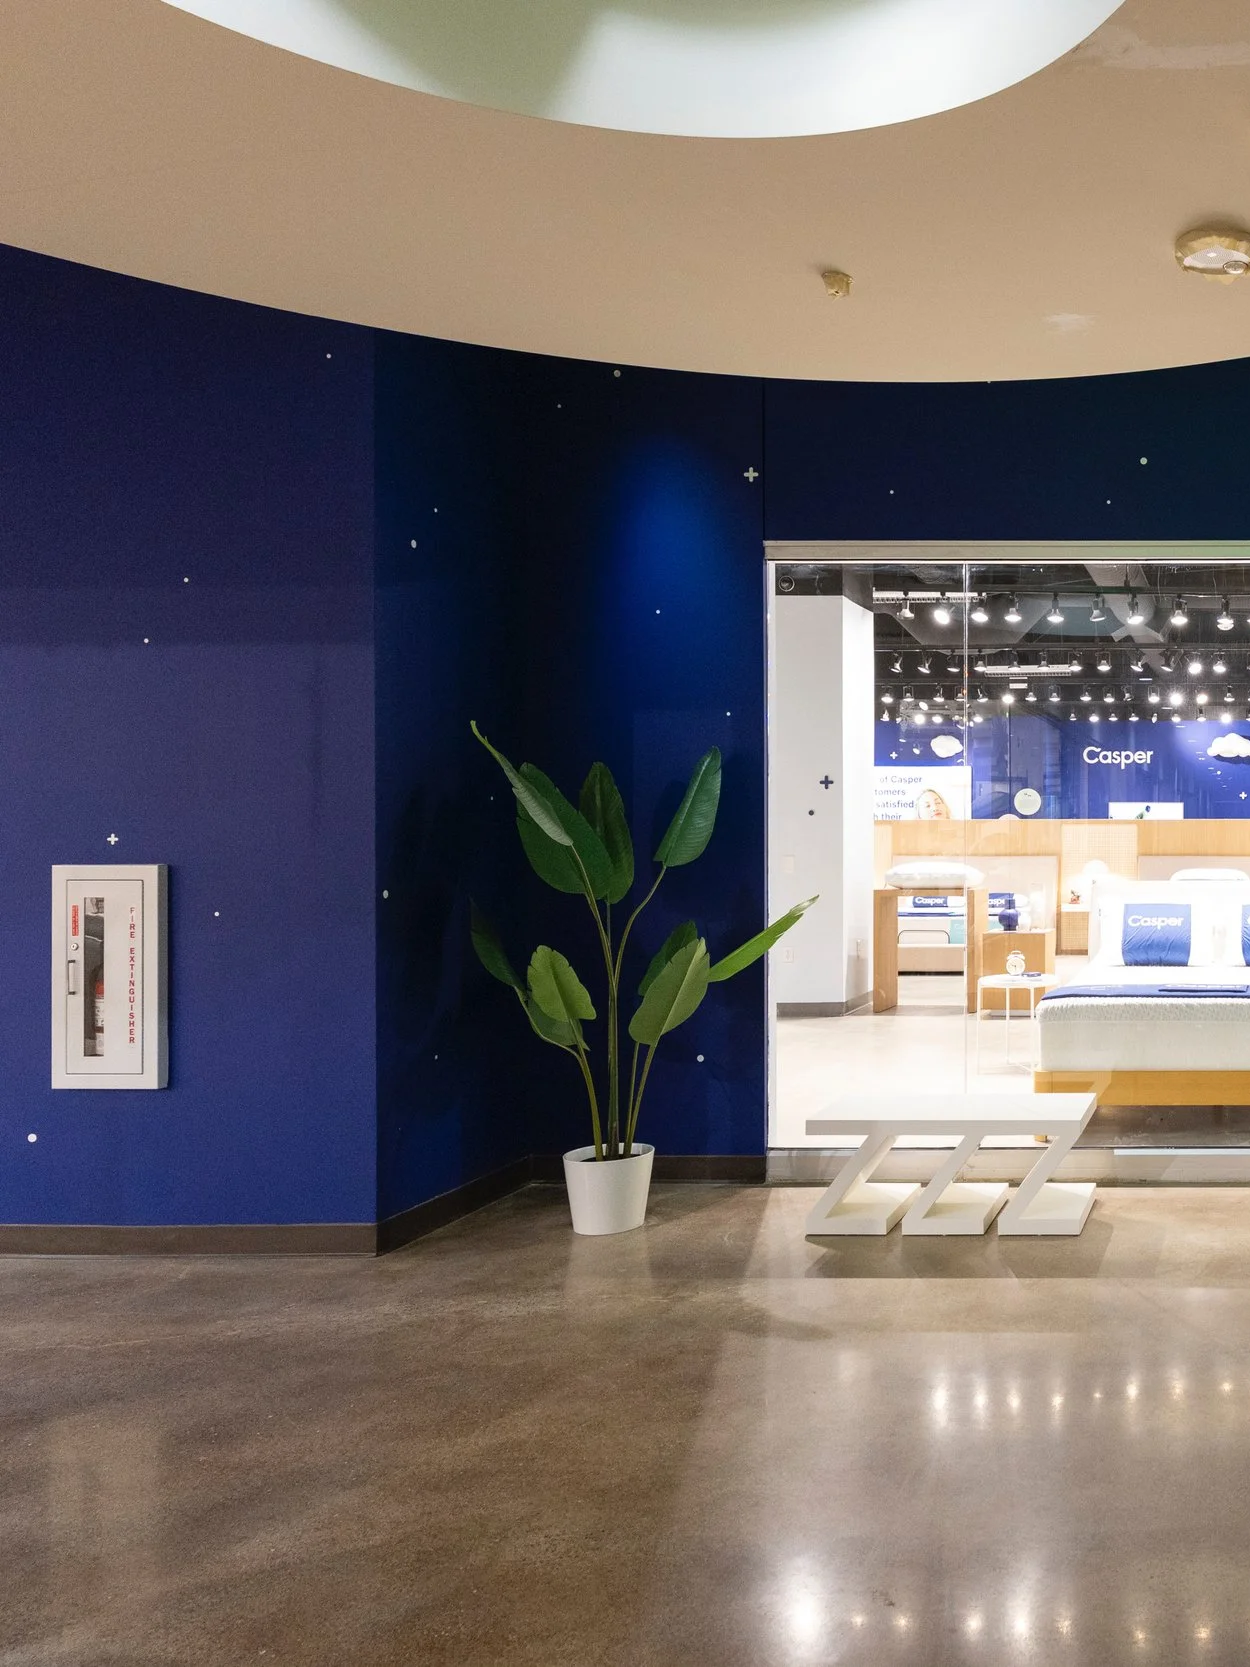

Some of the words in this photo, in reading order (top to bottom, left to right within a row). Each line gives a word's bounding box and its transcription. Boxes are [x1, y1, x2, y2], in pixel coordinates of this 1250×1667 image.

[1083, 746, 1153, 769] Casper
[891, 776, 922, 784] Casper
[876, 800, 914, 808] satisfied
[881, 812, 902, 820] their
[915, 897, 944, 906] Casper
[1128, 915, 1184, 930] Casper
[128, 948, 136, 1044] EXTINGUISHER
